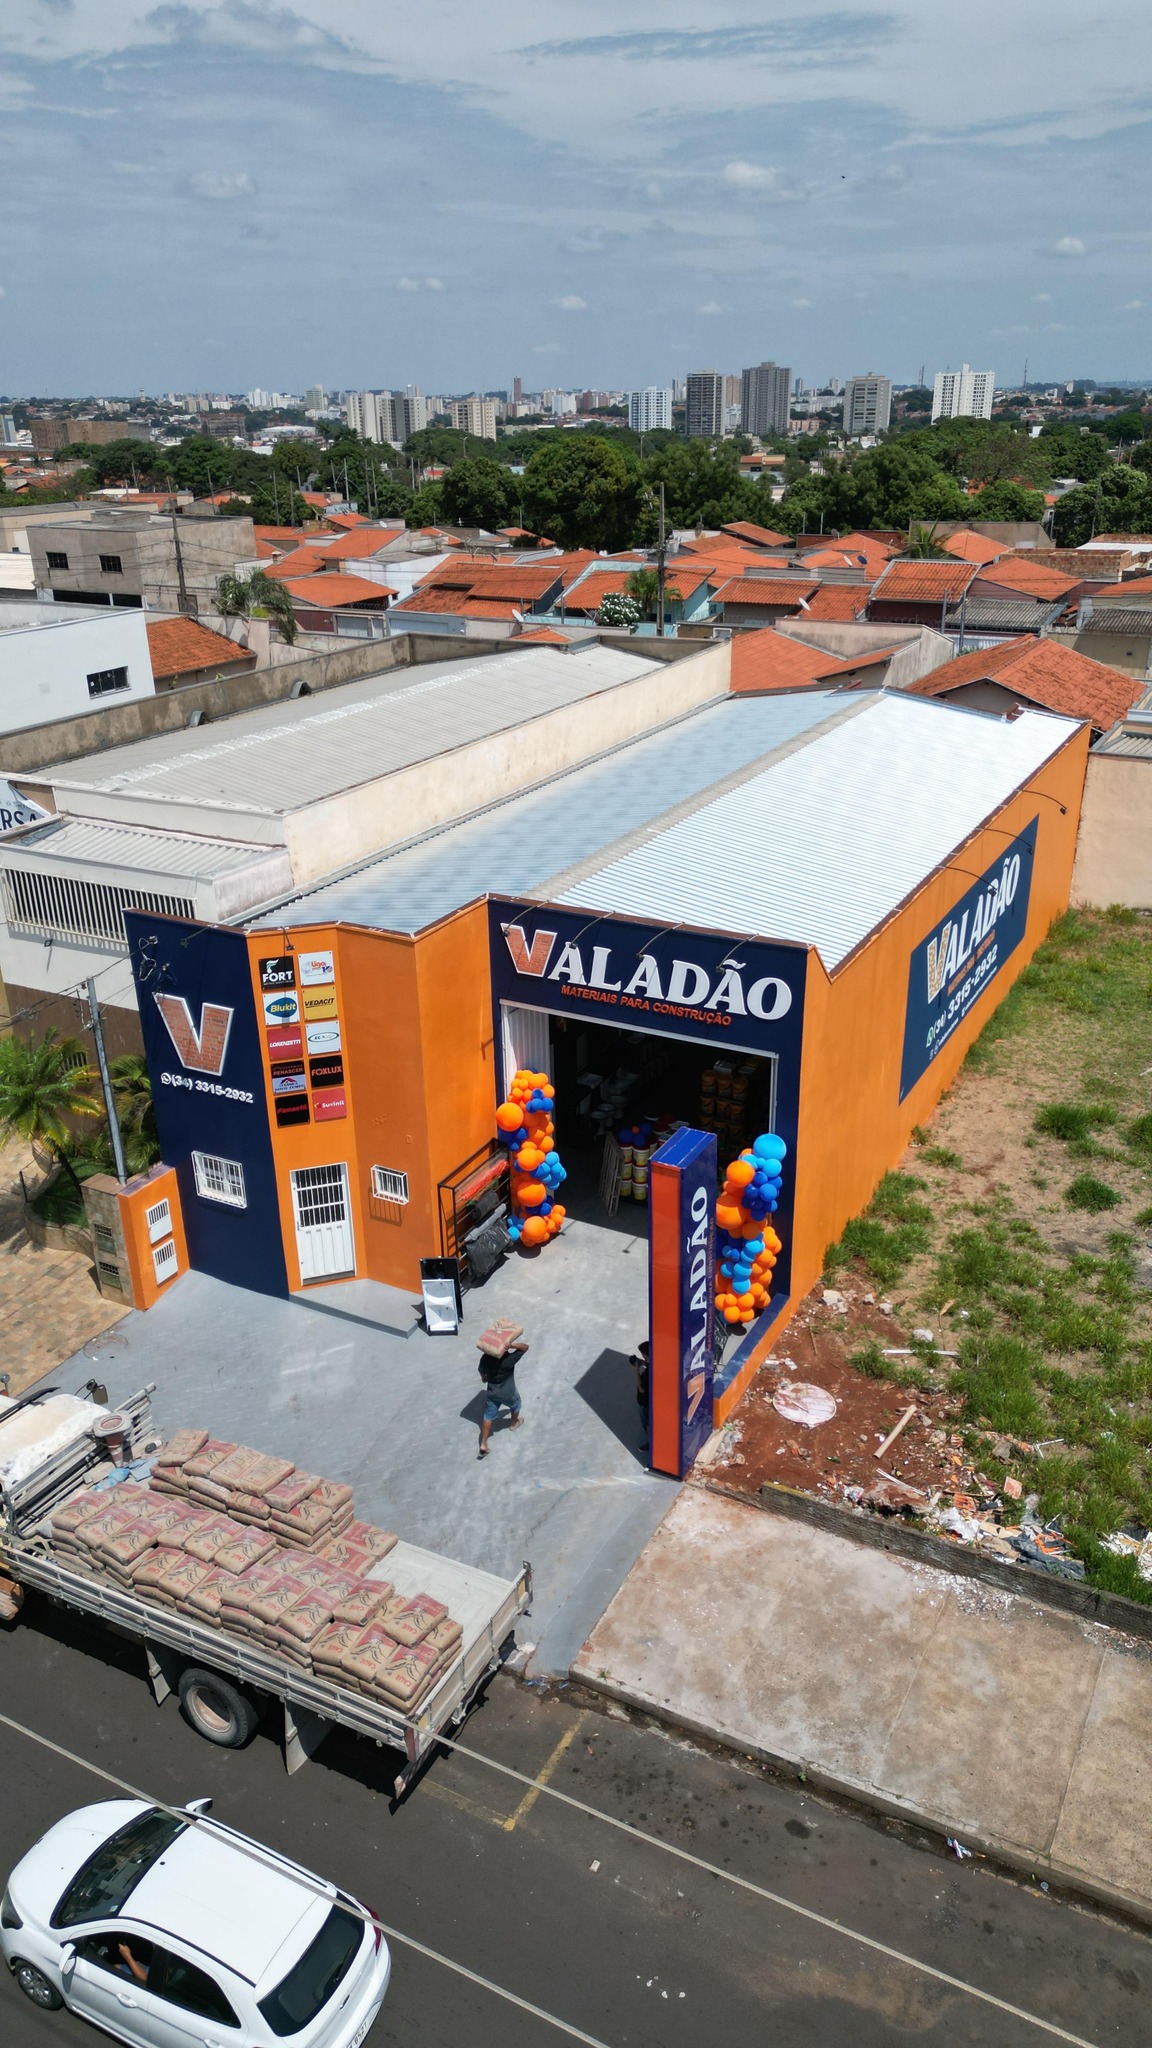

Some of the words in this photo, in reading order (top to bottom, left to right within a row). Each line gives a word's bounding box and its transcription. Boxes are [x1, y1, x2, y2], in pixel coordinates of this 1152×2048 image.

[927, 853, 1021, 1004] VALADÃO
[262, 970, 293, 983] FORT
[499, 922, 793, 1021] VALADÃO
[270, 1003, 297, 1013] Blukit
[305, 997, 335, 1007] VEDACIT
[560, 984, 618, 1005] MATERIAIS
[620, 995, 650, 1011] PARA
[652, 1002, 732, 1027] CONSTRUÇÃO
[152, 991, 235, 1077] V
[311, 1065, 342, 1076] FOXLUX
[171, 1075, 193, 1091] (34)
[195, 1080, 254, 1104] 3315-2932
[322, 1100, 344, 1109] Suvinil
[686, 1185, 708, 1426] VALADÃO
